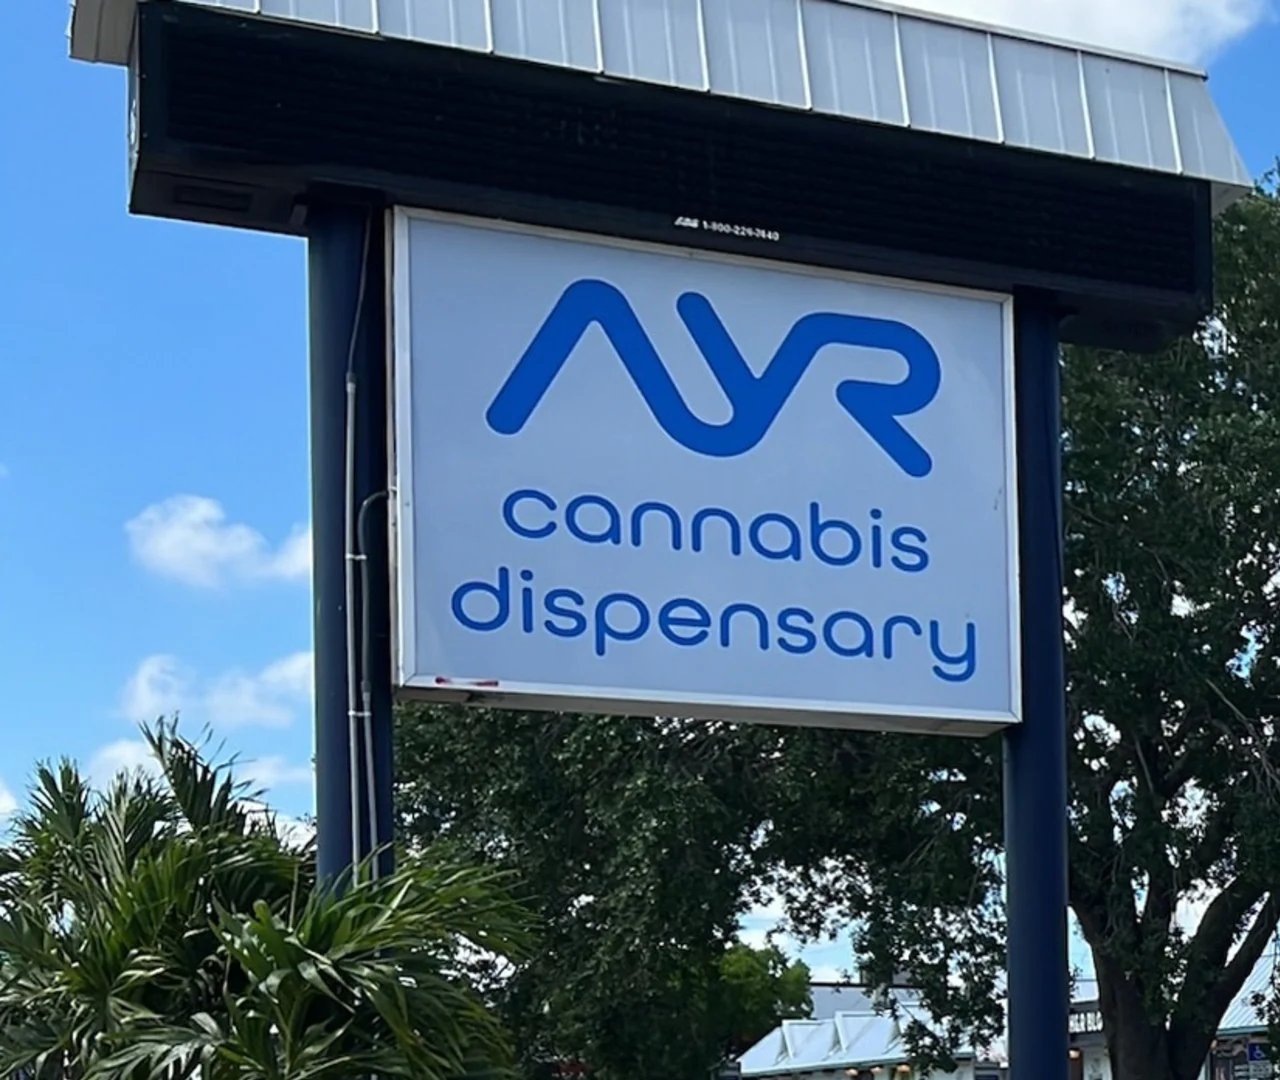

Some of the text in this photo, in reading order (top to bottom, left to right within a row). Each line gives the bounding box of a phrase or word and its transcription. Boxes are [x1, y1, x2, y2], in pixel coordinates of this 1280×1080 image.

[485, 278, 941, 478] AYR
[503, 489, 929, 573] cannabis
[450, 566, 976, 682] dispensary
